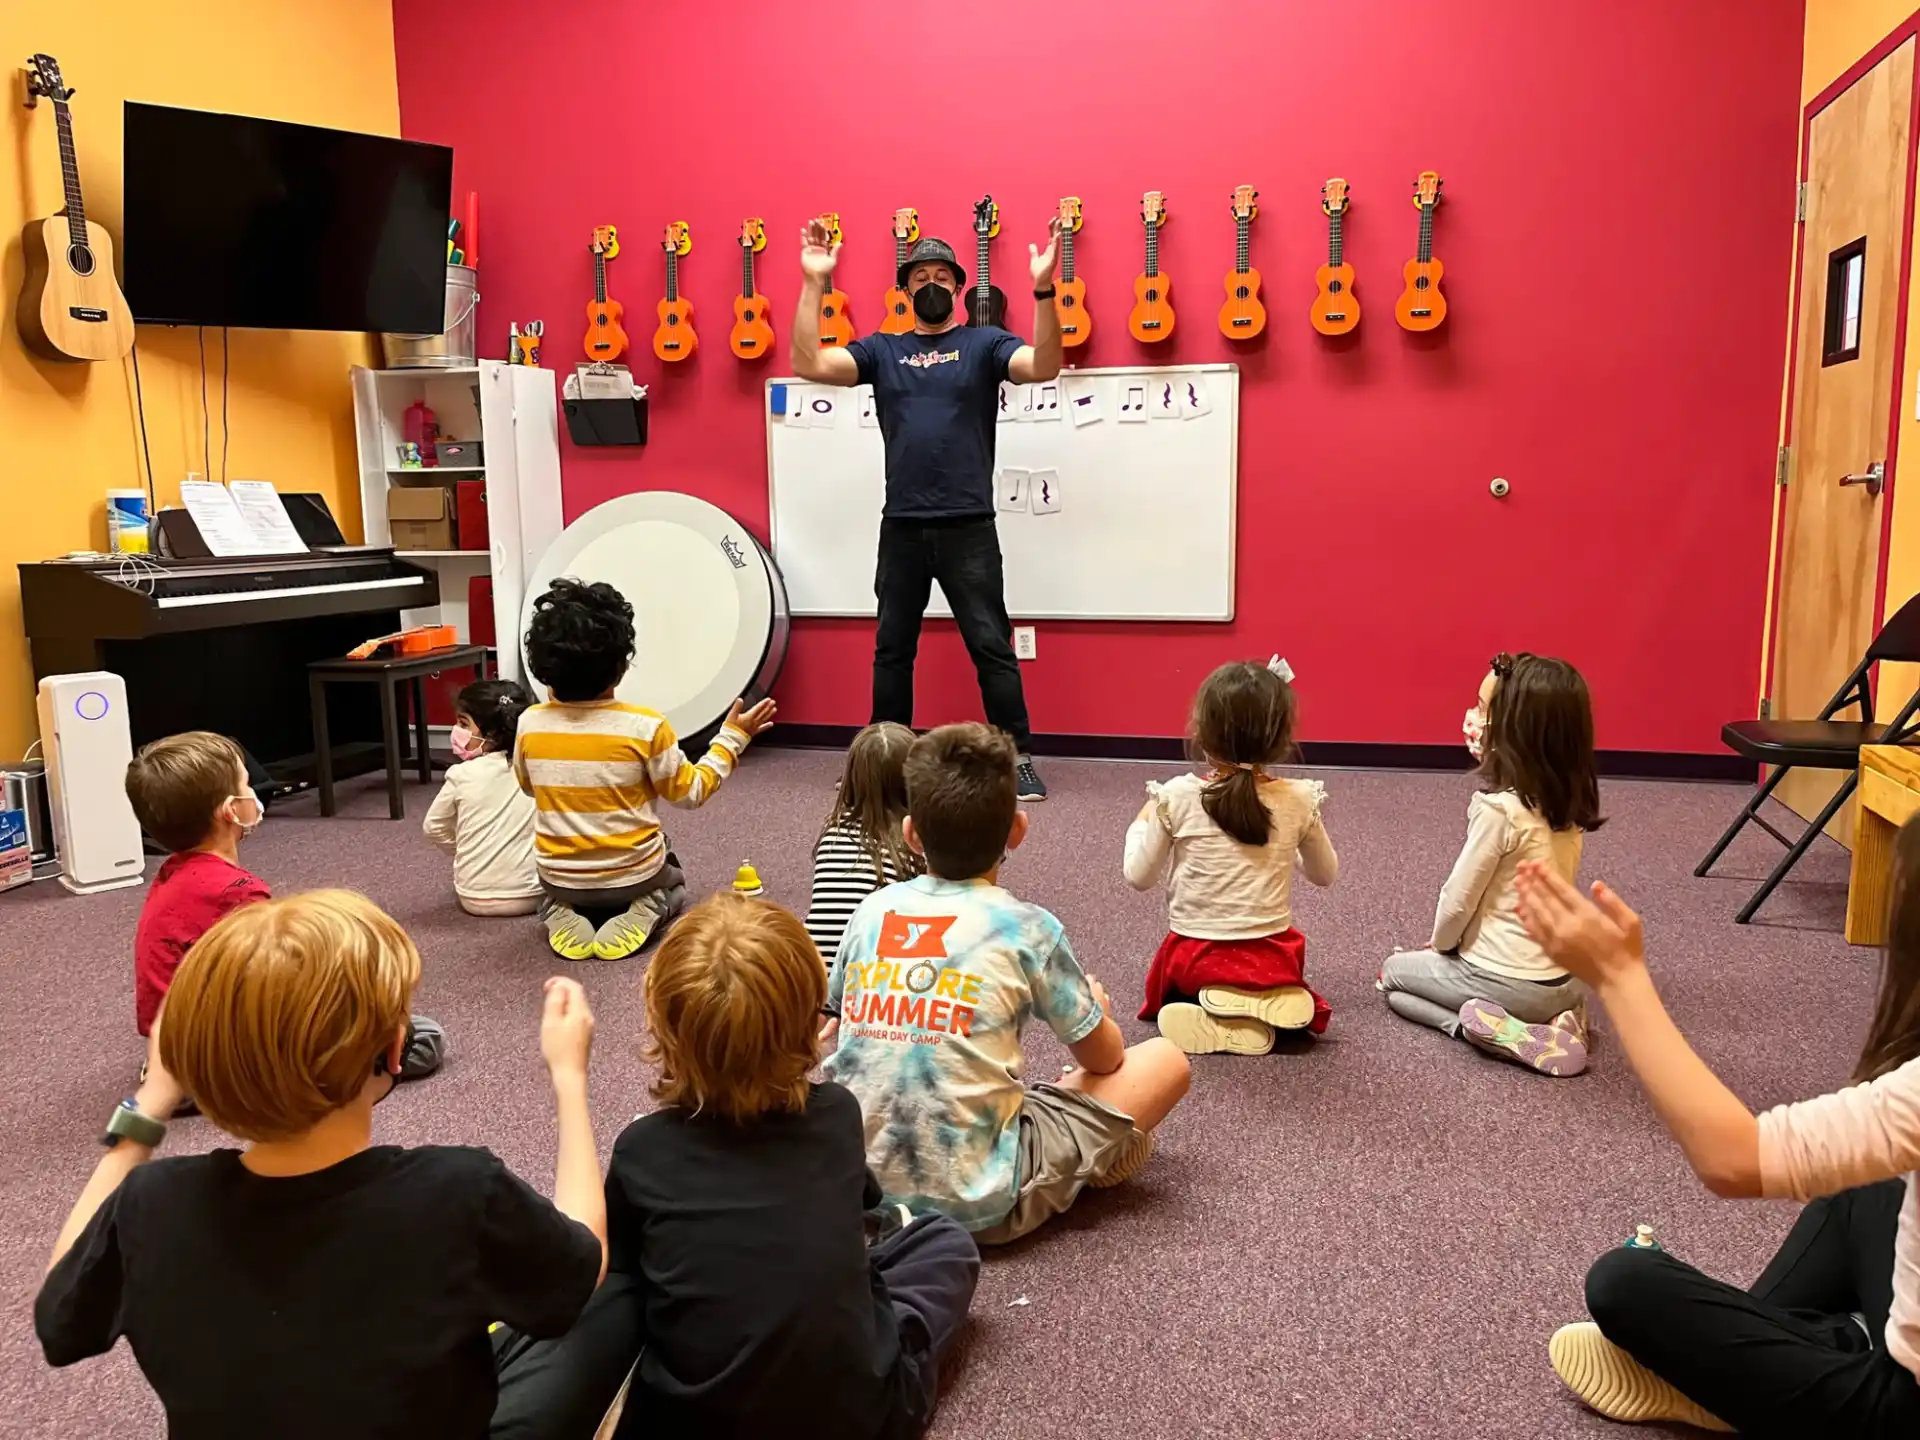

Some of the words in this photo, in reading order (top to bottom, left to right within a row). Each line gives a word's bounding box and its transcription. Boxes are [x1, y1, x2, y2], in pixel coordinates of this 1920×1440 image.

[723, 542, 741, 566] REMO
[845, 960, 984, 1005] EXPLORE
[843, 993, 974, 1038] SUMMER
[851, 1027, 888, 1040] UMMER
[890, 1031, 909, 1042] DAY
[910, 1033, 941, 1046] CAMP
